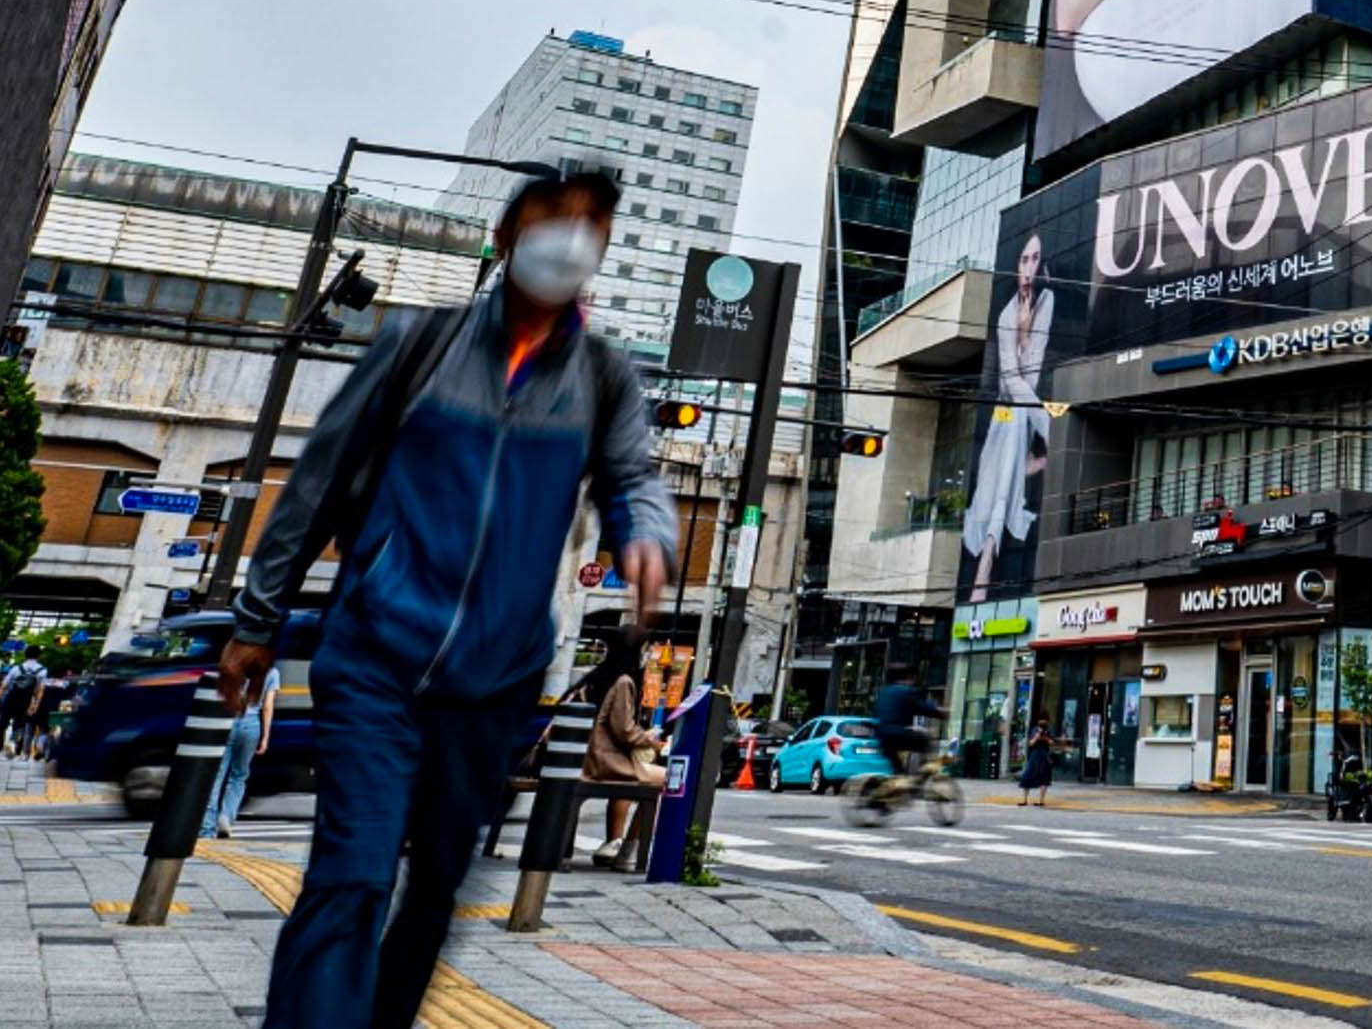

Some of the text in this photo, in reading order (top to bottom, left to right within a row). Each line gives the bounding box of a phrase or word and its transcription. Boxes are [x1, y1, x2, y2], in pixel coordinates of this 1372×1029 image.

[1144, 249, 1335, 310] 부드러움의 신세계 어노브
[1238, 316, 1371, 365] KDB산업은행
[1180, 582, 1283, 612] MOM'S TOUCH
